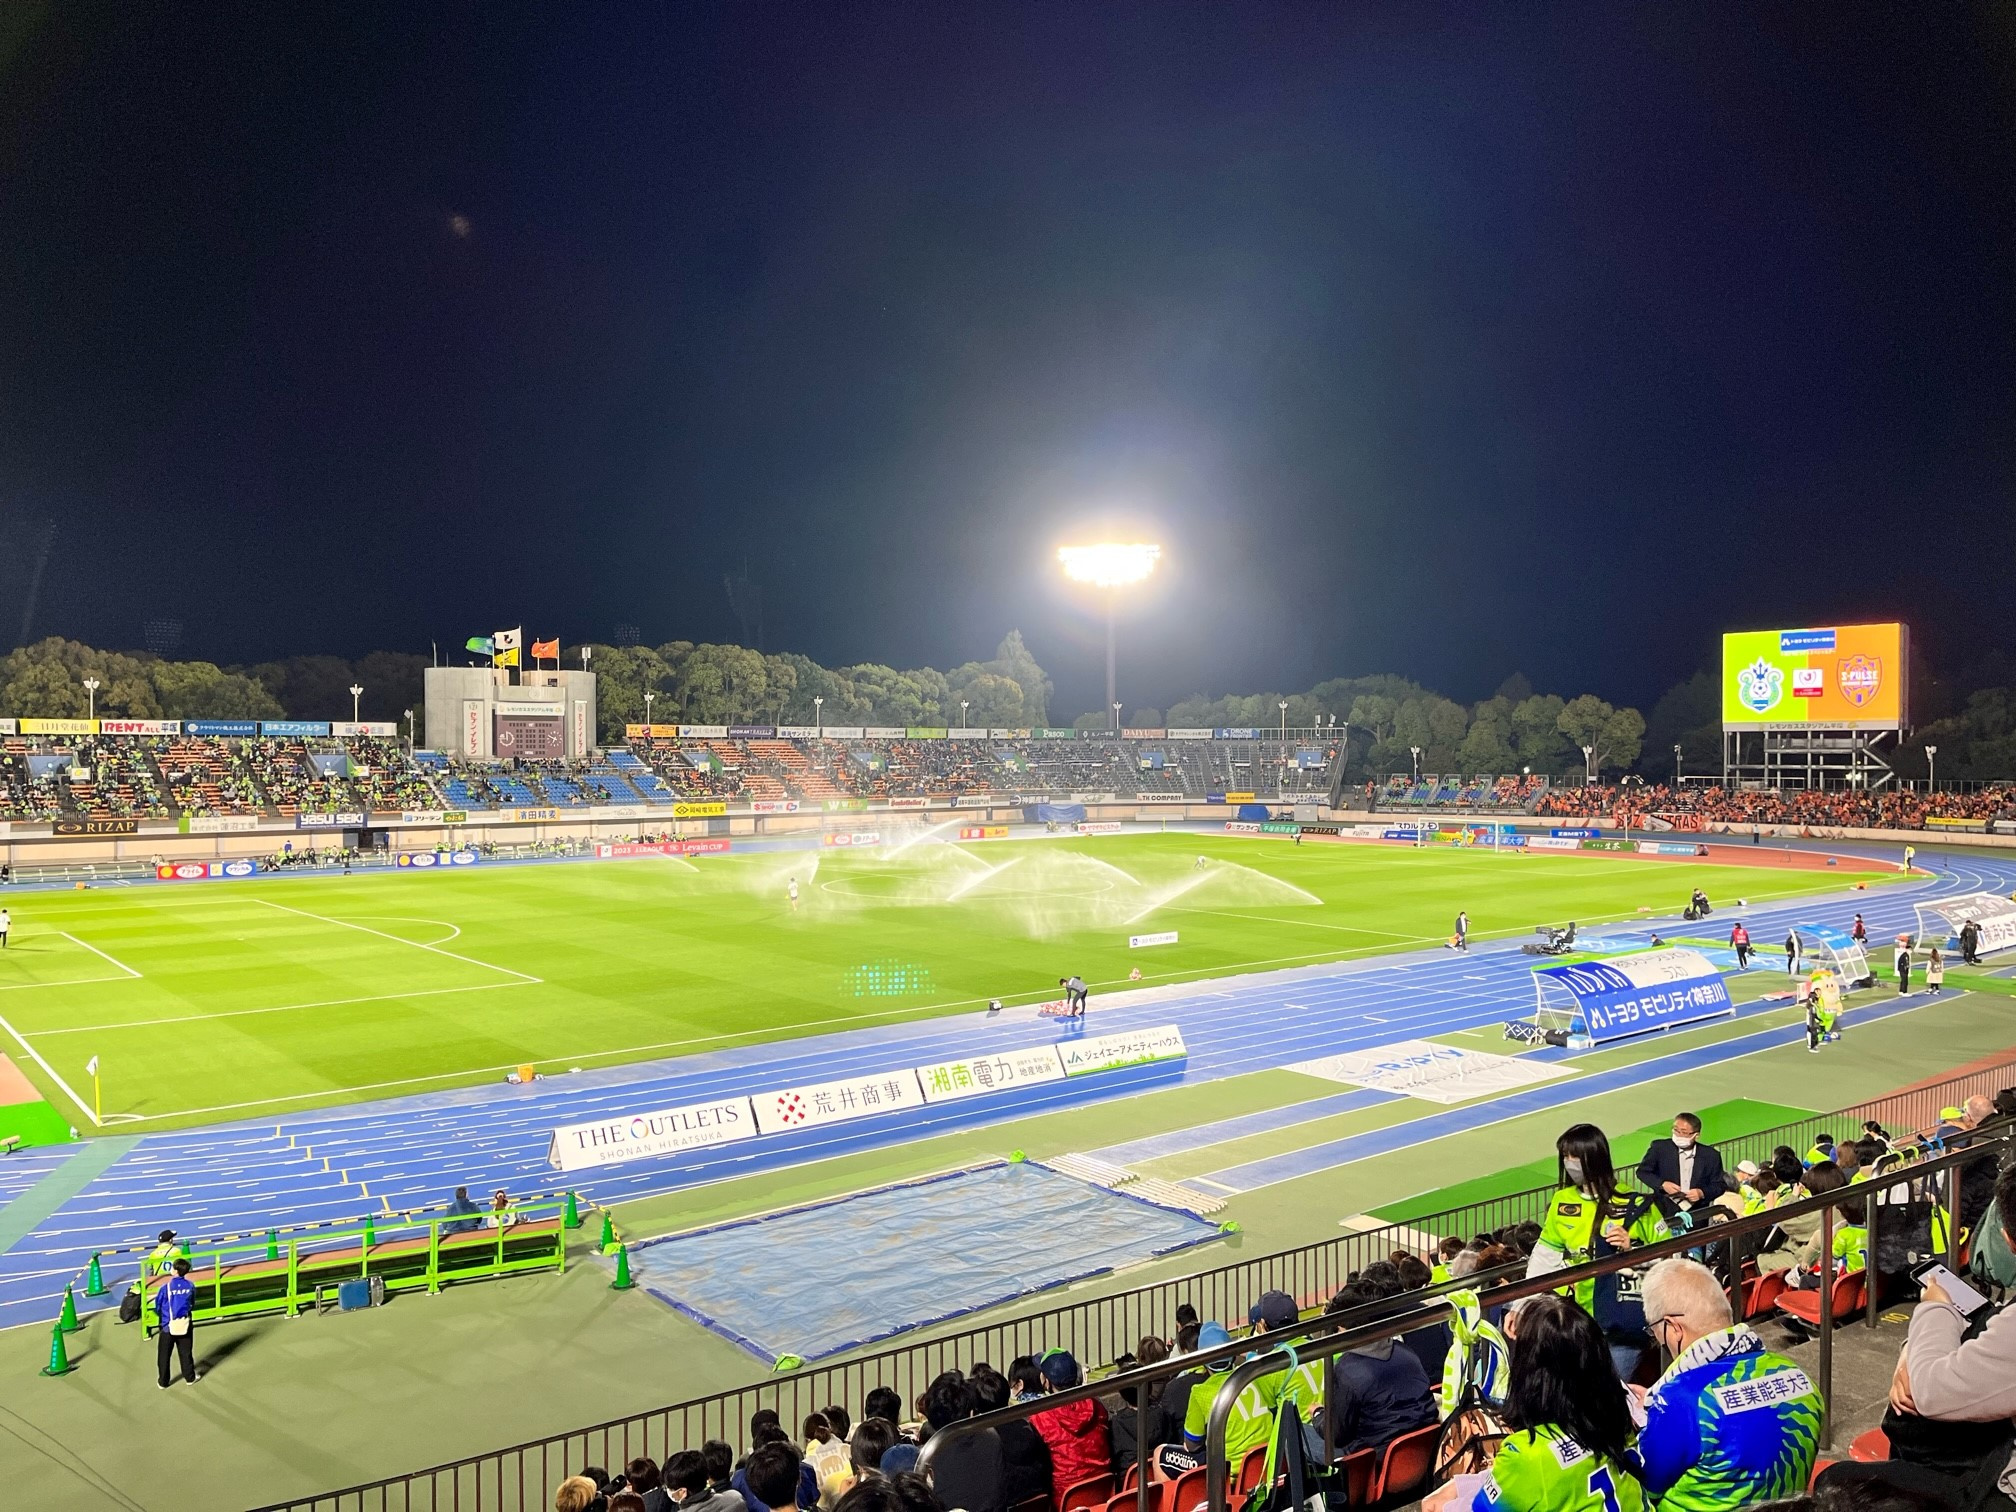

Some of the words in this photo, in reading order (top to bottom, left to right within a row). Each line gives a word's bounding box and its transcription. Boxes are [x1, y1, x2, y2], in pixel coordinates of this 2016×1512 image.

[104, 722, 144, 733] RENT
[1042, 729, 1065, 738] Pasco
[86, 821, 135, 833] RIZAP
[336, 813, 364, 824] SEIKI
[1314, 827, 1337, 835] RIZAP
[682, 844, 709, 852] Levain
[1606, 1003, 1640, 1026] トヨタ
[1641, 982, 1727, 1017] モビリティ神奈川
[1084, 1036, 1180, 1061] ジェイエーアメニティーハウス
[926, 1057, 1014, 1095] 湘南電力
[1019, 1062, 1053, 1078] 地産地消
[812, 1080, 902, 1115] 荒井商事
[572, 1124, 625, 1149] THE
[630, 1104, 738, 1140] OUTLETS
[600, 1143, 652, 1161] SHONAN
[659, 1131, 723, 1150] HIRATSUKA
[1234, 1382, 1269, 1422] 12
[1721, 1373, 1809, 1410] 産業能率大学
